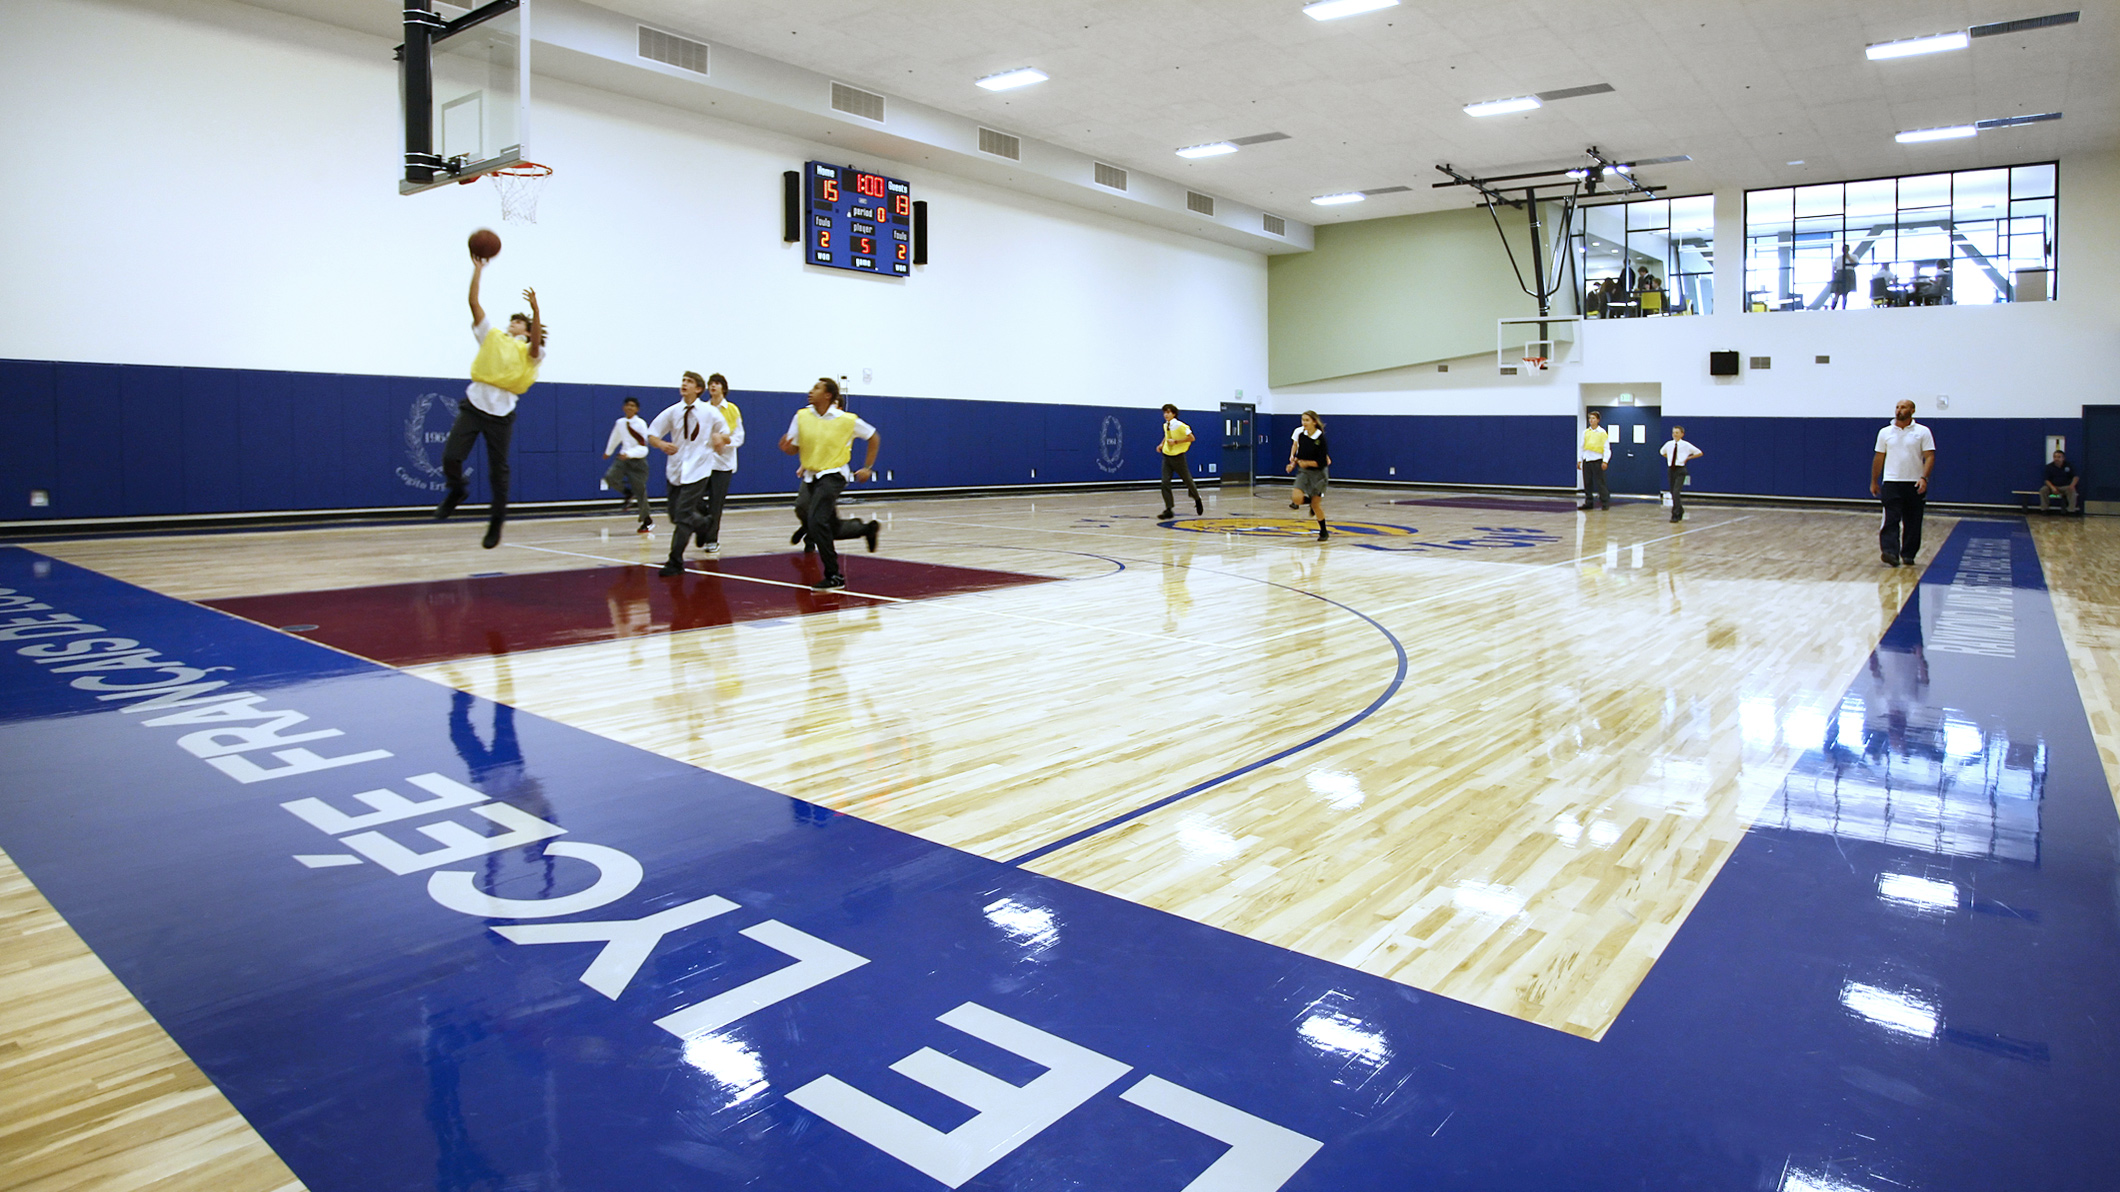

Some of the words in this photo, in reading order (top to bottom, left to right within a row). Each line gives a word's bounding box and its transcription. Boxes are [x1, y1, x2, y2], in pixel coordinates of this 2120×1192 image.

[817, 165, 834, 178] Home
[823, 180, 838, 201] 15
[857, 174, 884, 198] 1:00
[888, 181, 907, 193] Guests
[853, 207, 872, 218] period
[895, 195, 909, 216] 13
[816, 216, 830, 227] fouls
[877, 207, 886, 222] 0
[853, 222, 872, 233] player
[894, 230, 907, 240] fouls
[821, 231, 830, 247] 2
[861, 238, 870, 253] 5
[898, 244, 907, 259] 2
[856, 258, 871, 267] game
[1927, 611, 2015, 658] RAYMOND
[16, 637, 395, 784] FRANÇAIS
[279, 772, 871, 1040] LYCÉE
[784, 1001, 1324, 1192] LE
